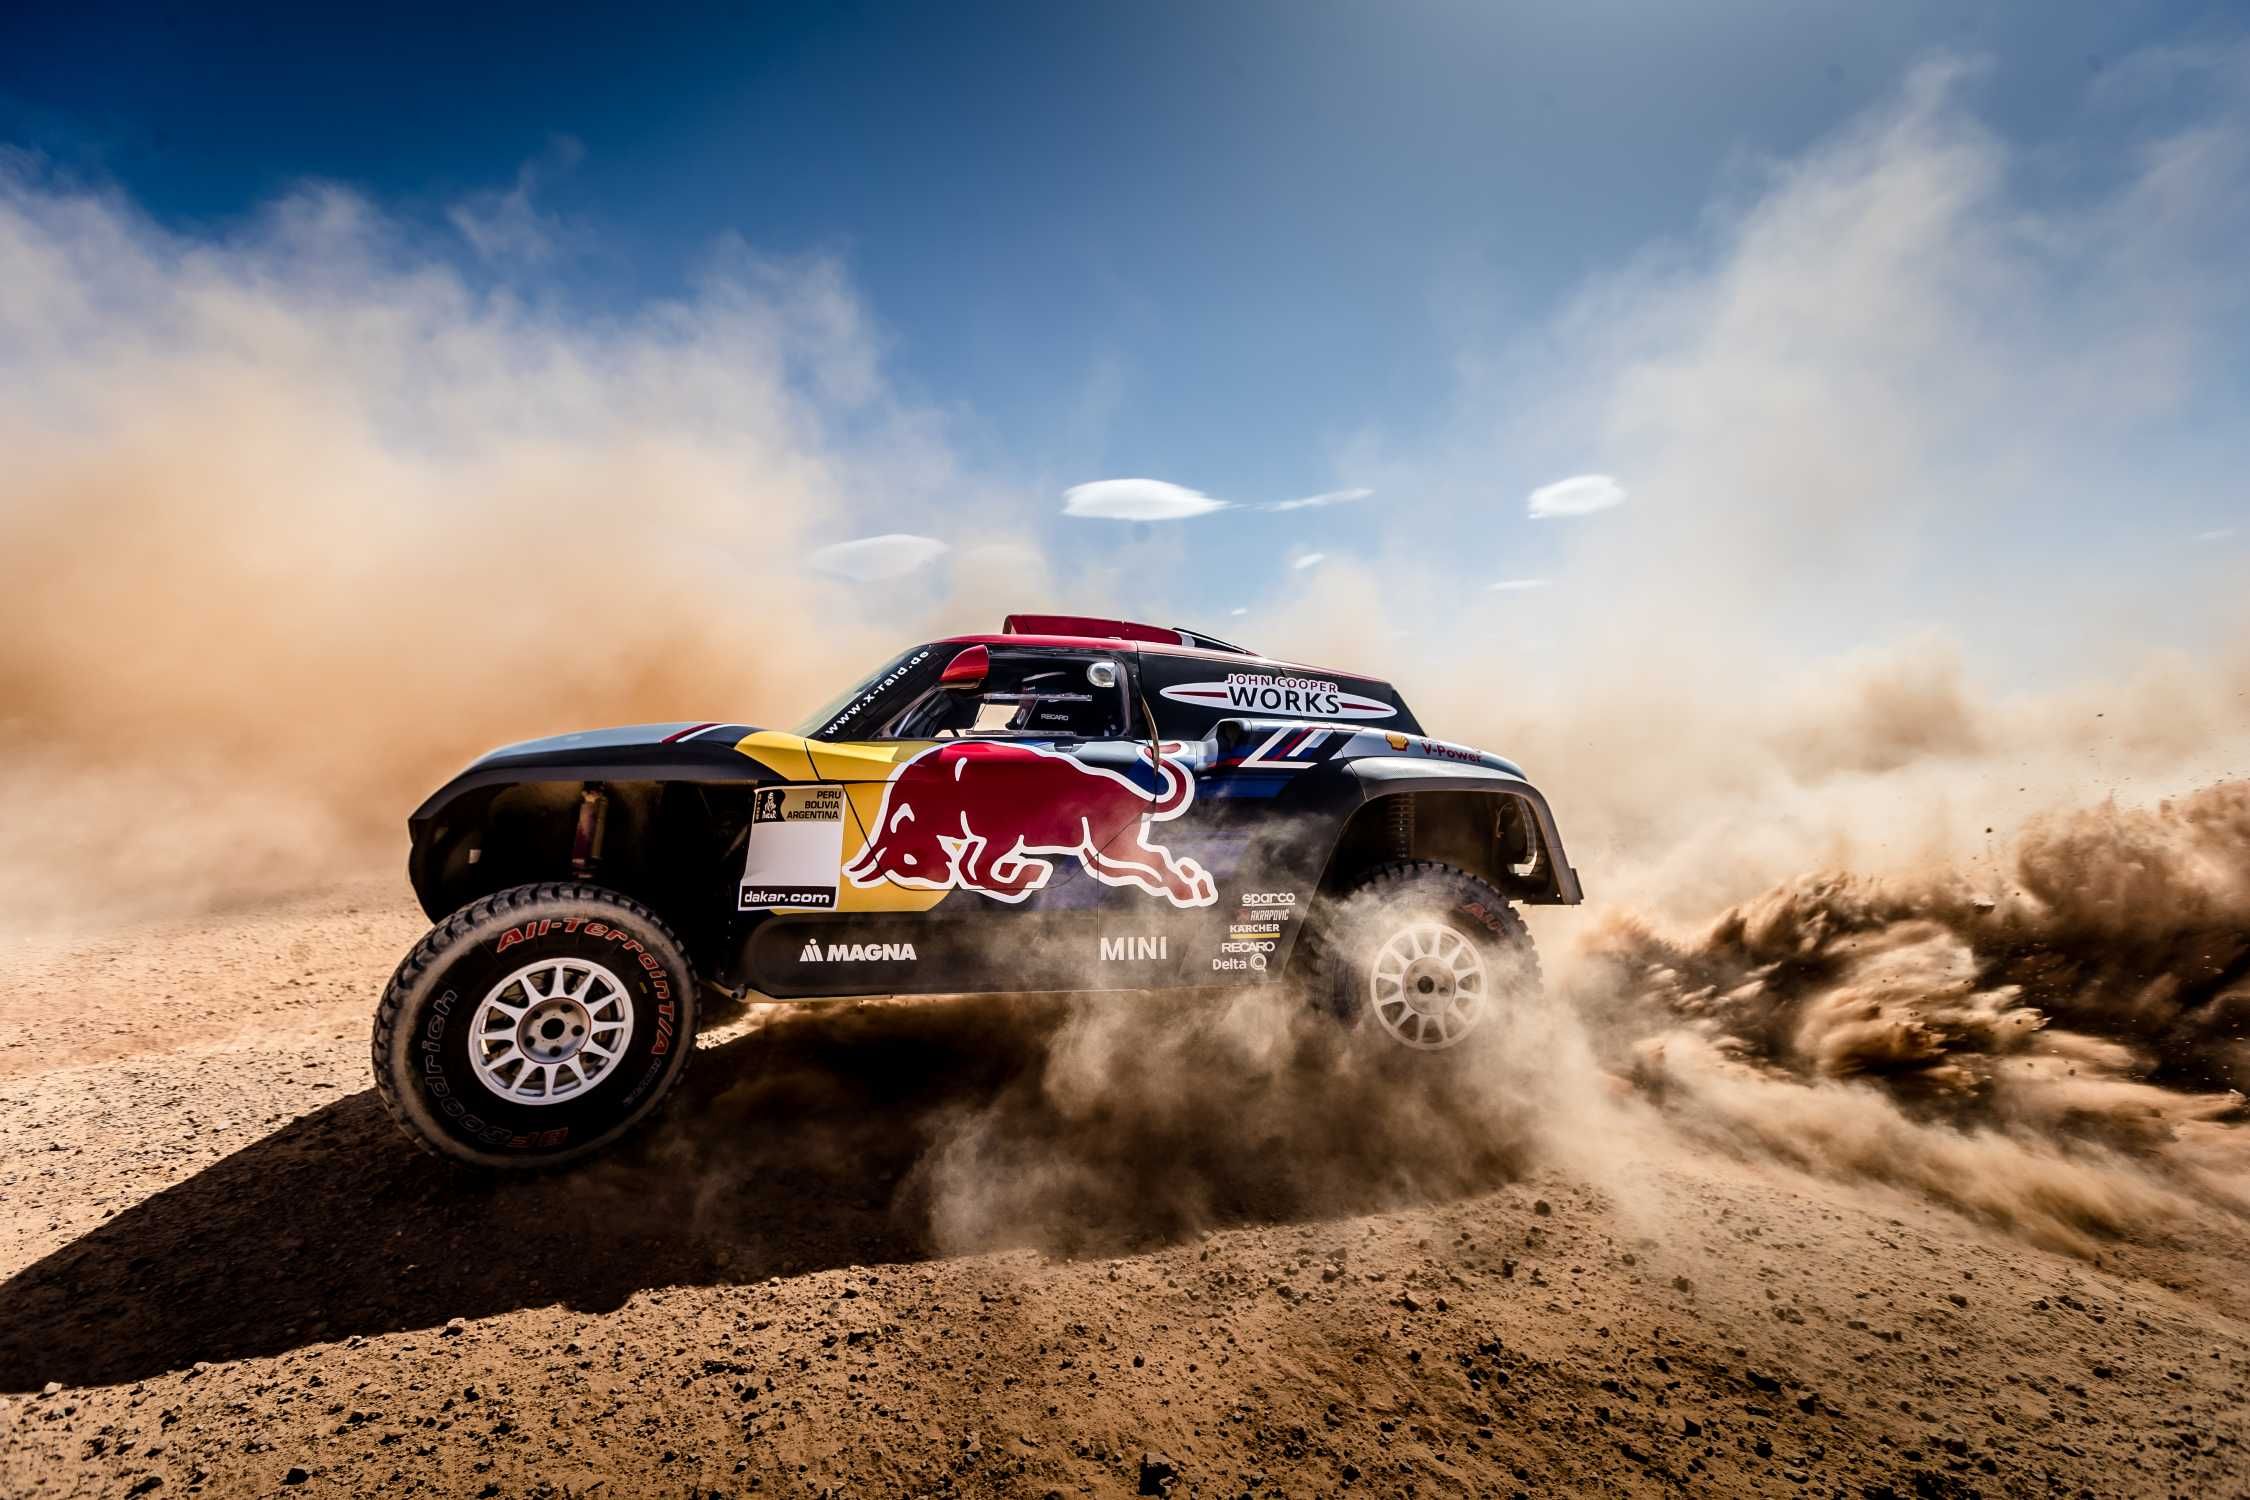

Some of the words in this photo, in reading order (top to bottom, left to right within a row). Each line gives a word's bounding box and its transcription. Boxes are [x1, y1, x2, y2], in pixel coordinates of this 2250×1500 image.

[1227, 674, 1272, 686] JOHN
[1278, 677, 1337, 693] COOPER
[1228, 686, 1341, 715] WORKS
[1040, 713, 1069, 721] RECARO
[1421, 742, 1482, 763] V-Power
[816, 791, 842, 799] PERU
[804, 801, 840, 809] BOLIVIA
[786, 811, 839, 819] ARGENTINA
[744, 891, 830, 903] dakar.com
[1241, 893, 1296, 907] sparco
[826, 943, 917, 961] MAGNA
[1100, 936, 1167, 960] MINI
[1222, 941, 1276, 953] RECARO
[1212, 958, 1247, 970] Delta
